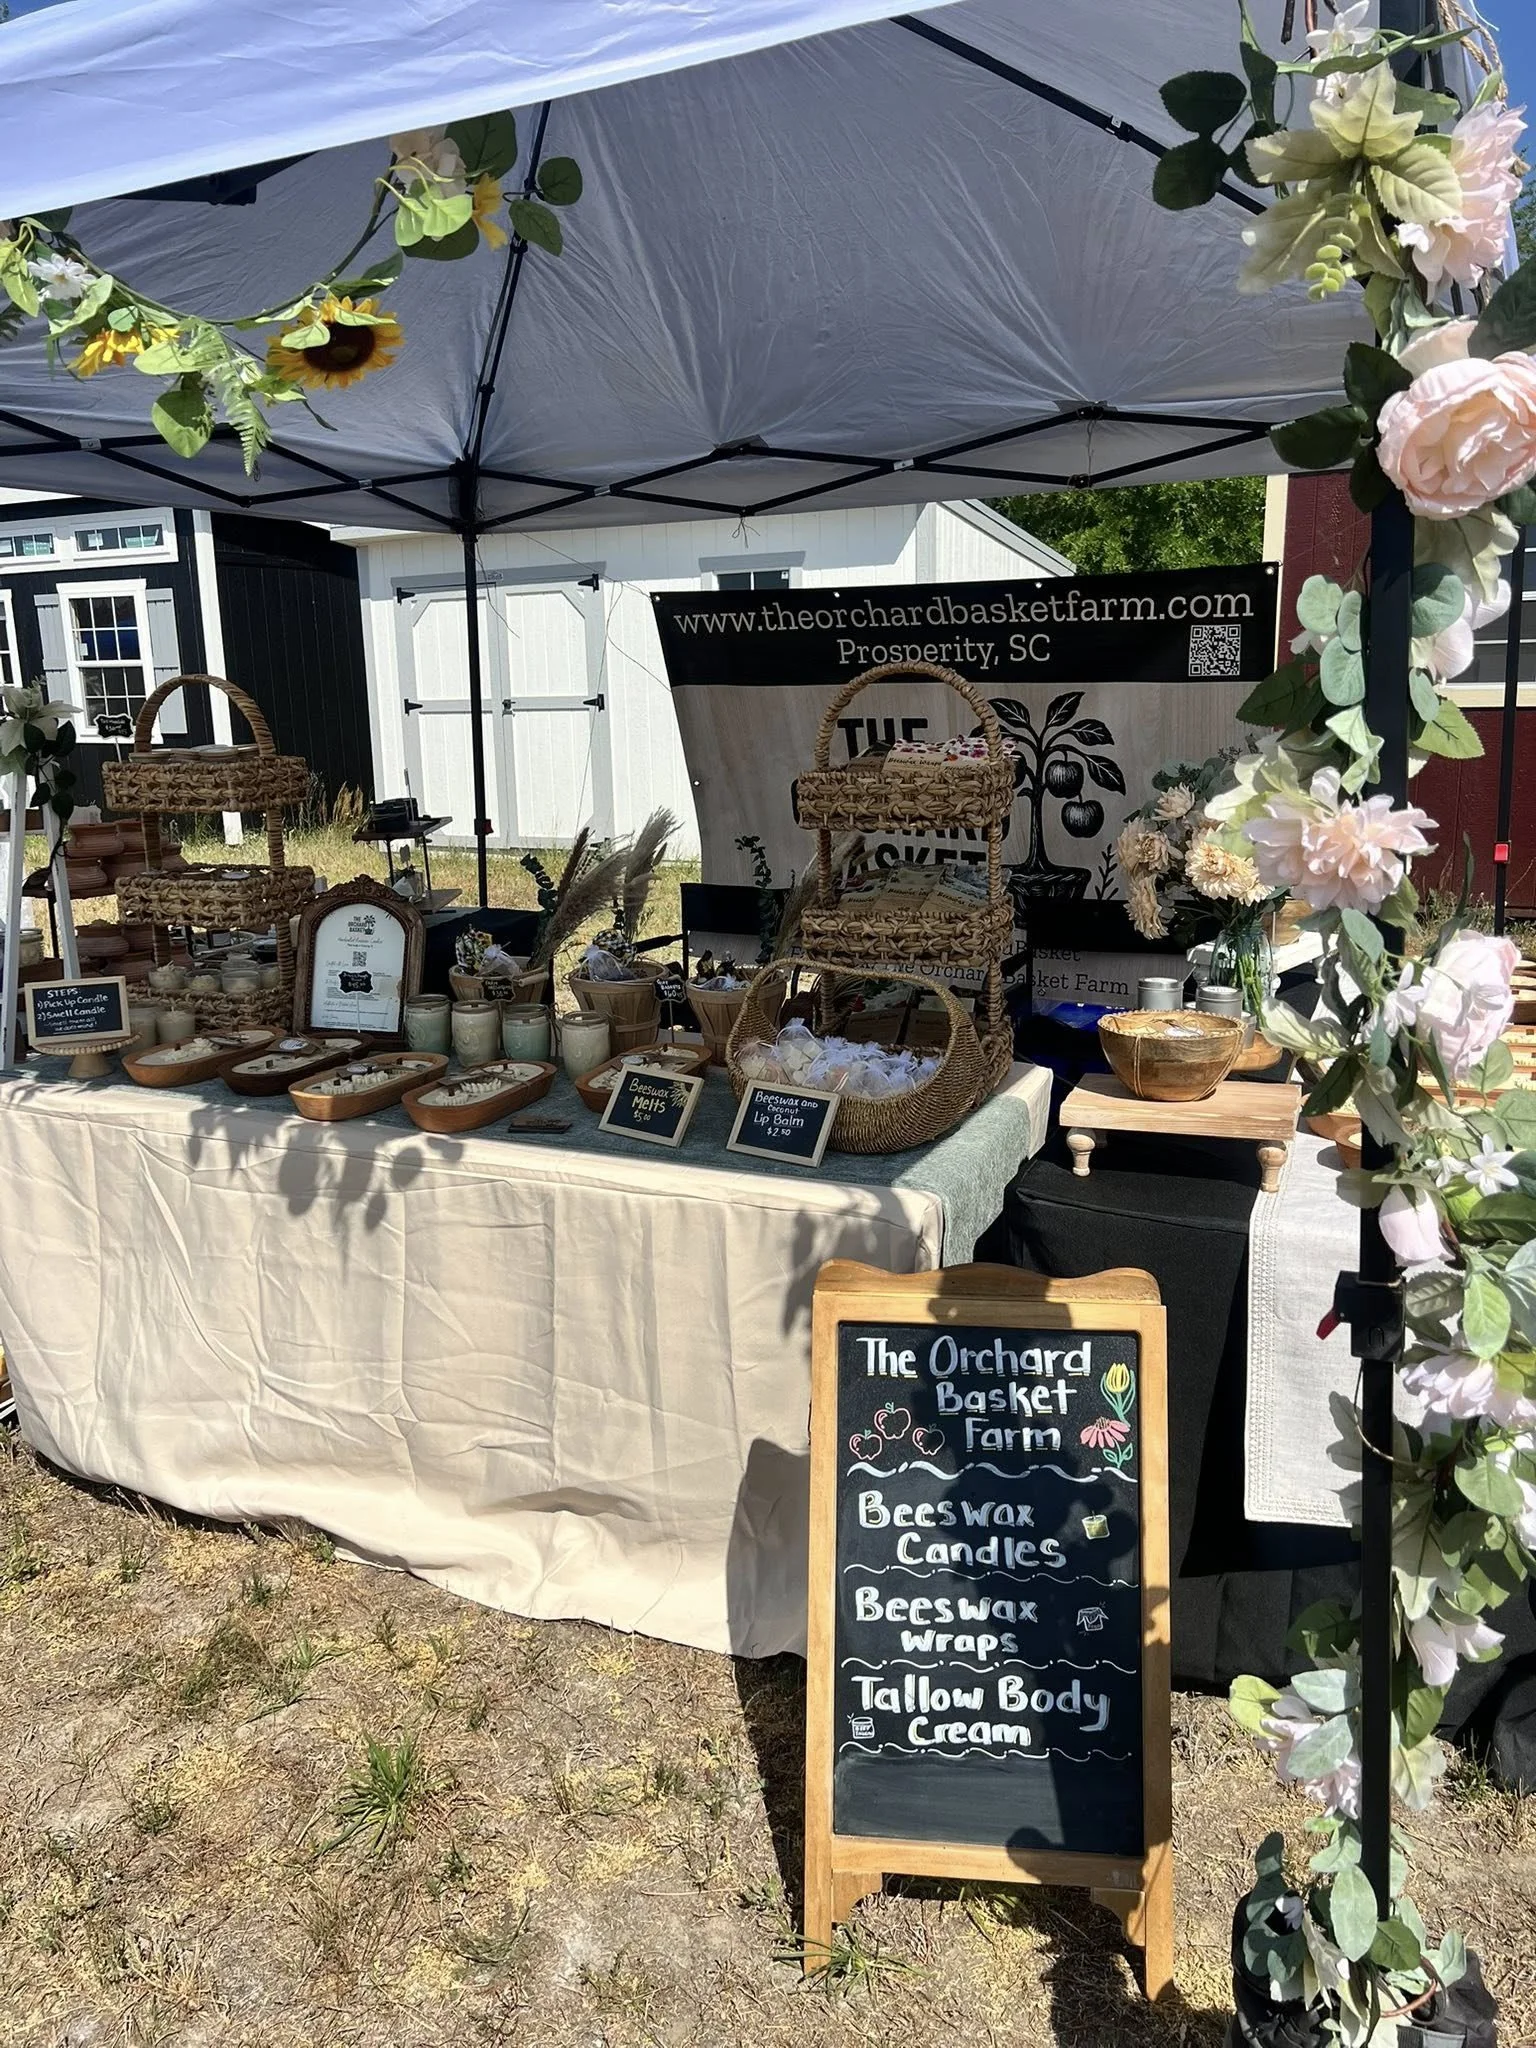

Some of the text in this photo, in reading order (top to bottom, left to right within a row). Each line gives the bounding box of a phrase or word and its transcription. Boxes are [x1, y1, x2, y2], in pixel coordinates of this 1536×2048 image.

[674, 591, 1254, 634] www.theorchardbasketfarm.com
[837, 634, 1050, 669] Prosperity, SC
[1075, 974, 1129, 995] Farm
[629, 1078, 669, 1098] Beeswax
[631, 1095, 666, 1114] Melts
[755, 1091, 799, 1107] Beeswax
[754, 1111, 804, 1127] Lip Balm
[856, 1335, 1092, 1377] The Orchard
[936, 1379, 1077, 1416] Basket
[965, 1417, 1061, 1451] Farm
[896, 1532, 1066, 1569] Candles
[854, 1586, 1038, 1625] Beeswax
[851, 1674, 1111, 1731] Tallow Body
[907, 1716, 1031, 1746] Cream
